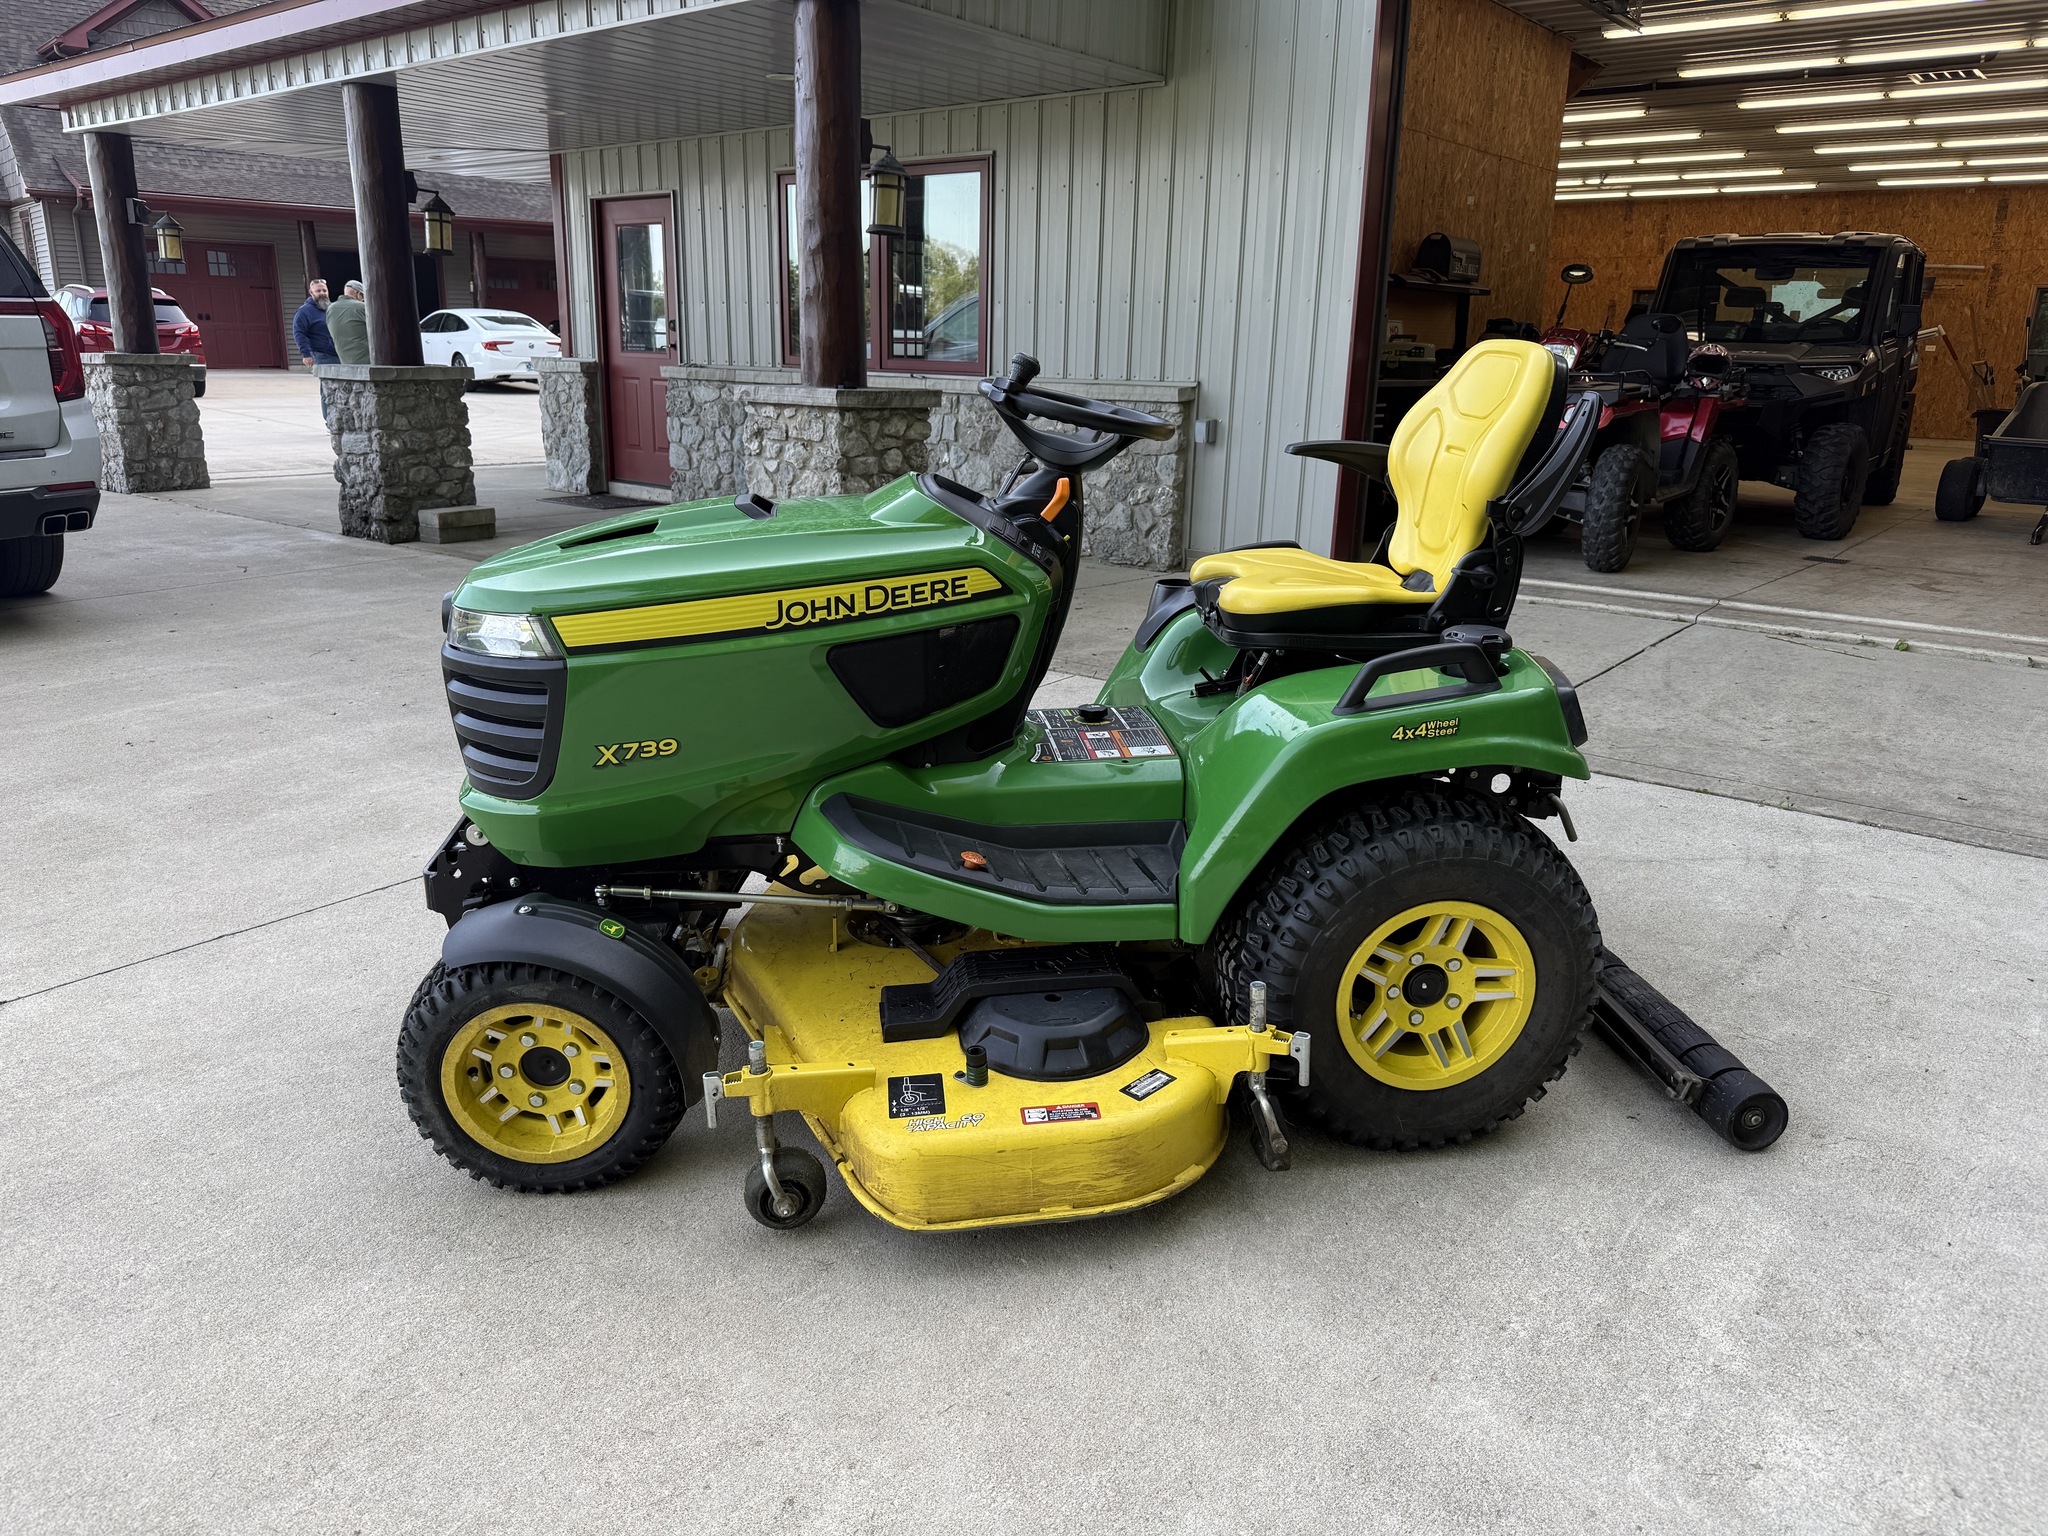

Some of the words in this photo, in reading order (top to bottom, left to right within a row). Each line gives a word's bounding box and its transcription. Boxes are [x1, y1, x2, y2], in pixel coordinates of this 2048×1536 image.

[765, 593, 857, 628] JOHN
[864, 576, 970, 612] DEERE
[1391, 722, 1427, 741] 4x4
[1427, 717, 1459, 730] Wheel
[1427, 727, 1458, 738] Steer
[594, 738, 679, 767] X739
[907, 1116, 946, 1128] HIGH
[961, 1113, 986, 1123] 60
